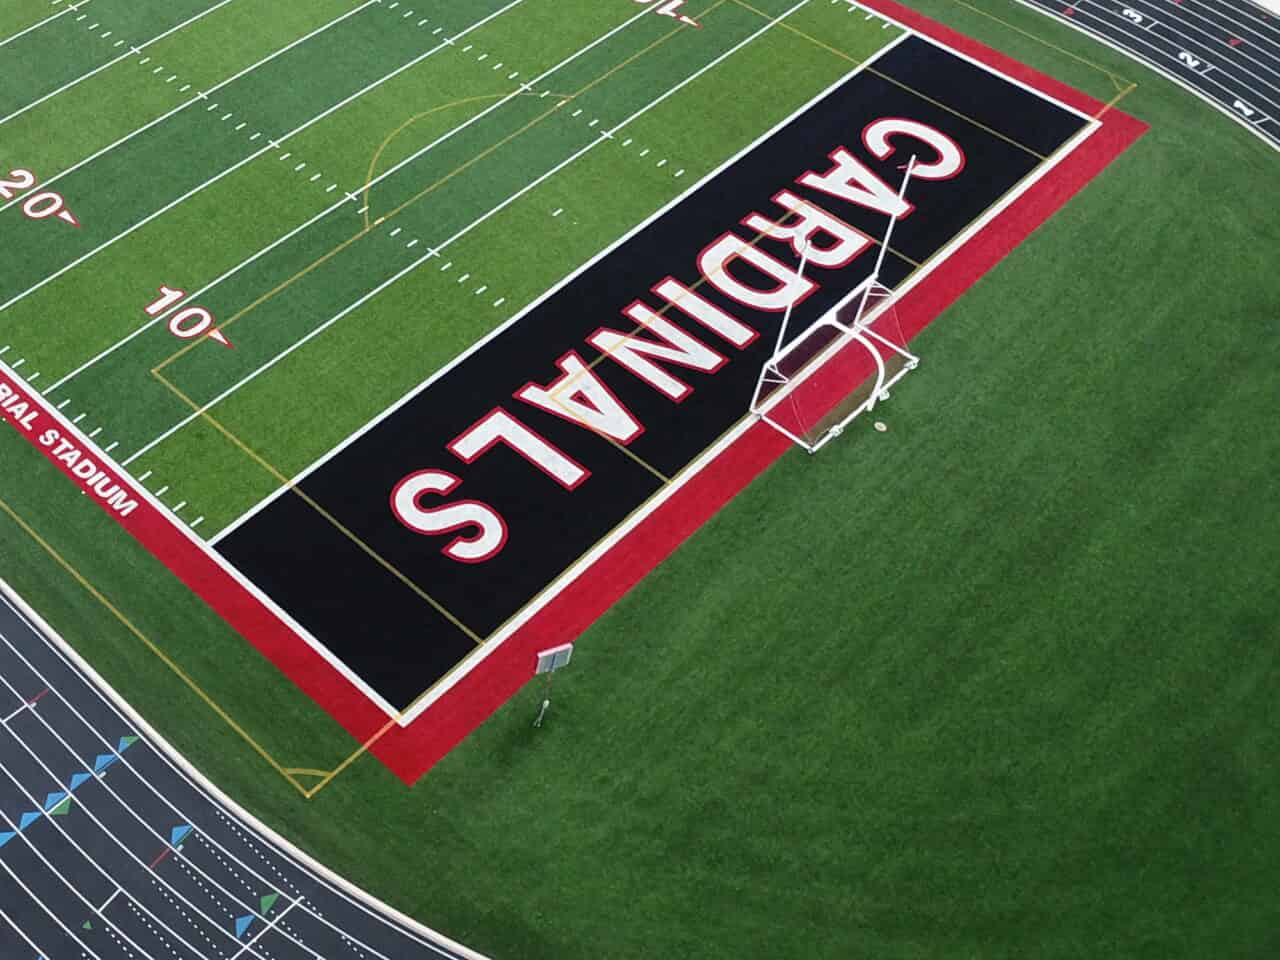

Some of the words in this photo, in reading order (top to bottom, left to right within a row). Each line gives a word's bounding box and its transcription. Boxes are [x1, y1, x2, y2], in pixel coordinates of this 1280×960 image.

[1122, 9, 1143, 24] 3
[1178, 51, 1200, 68] 2
[1233, 100, 1255, 116] 1
[144, 285, 213, 338] 10
[390, 116, 966, 563] CARDINALS
[39, 428, 139, 517] STADIUM
